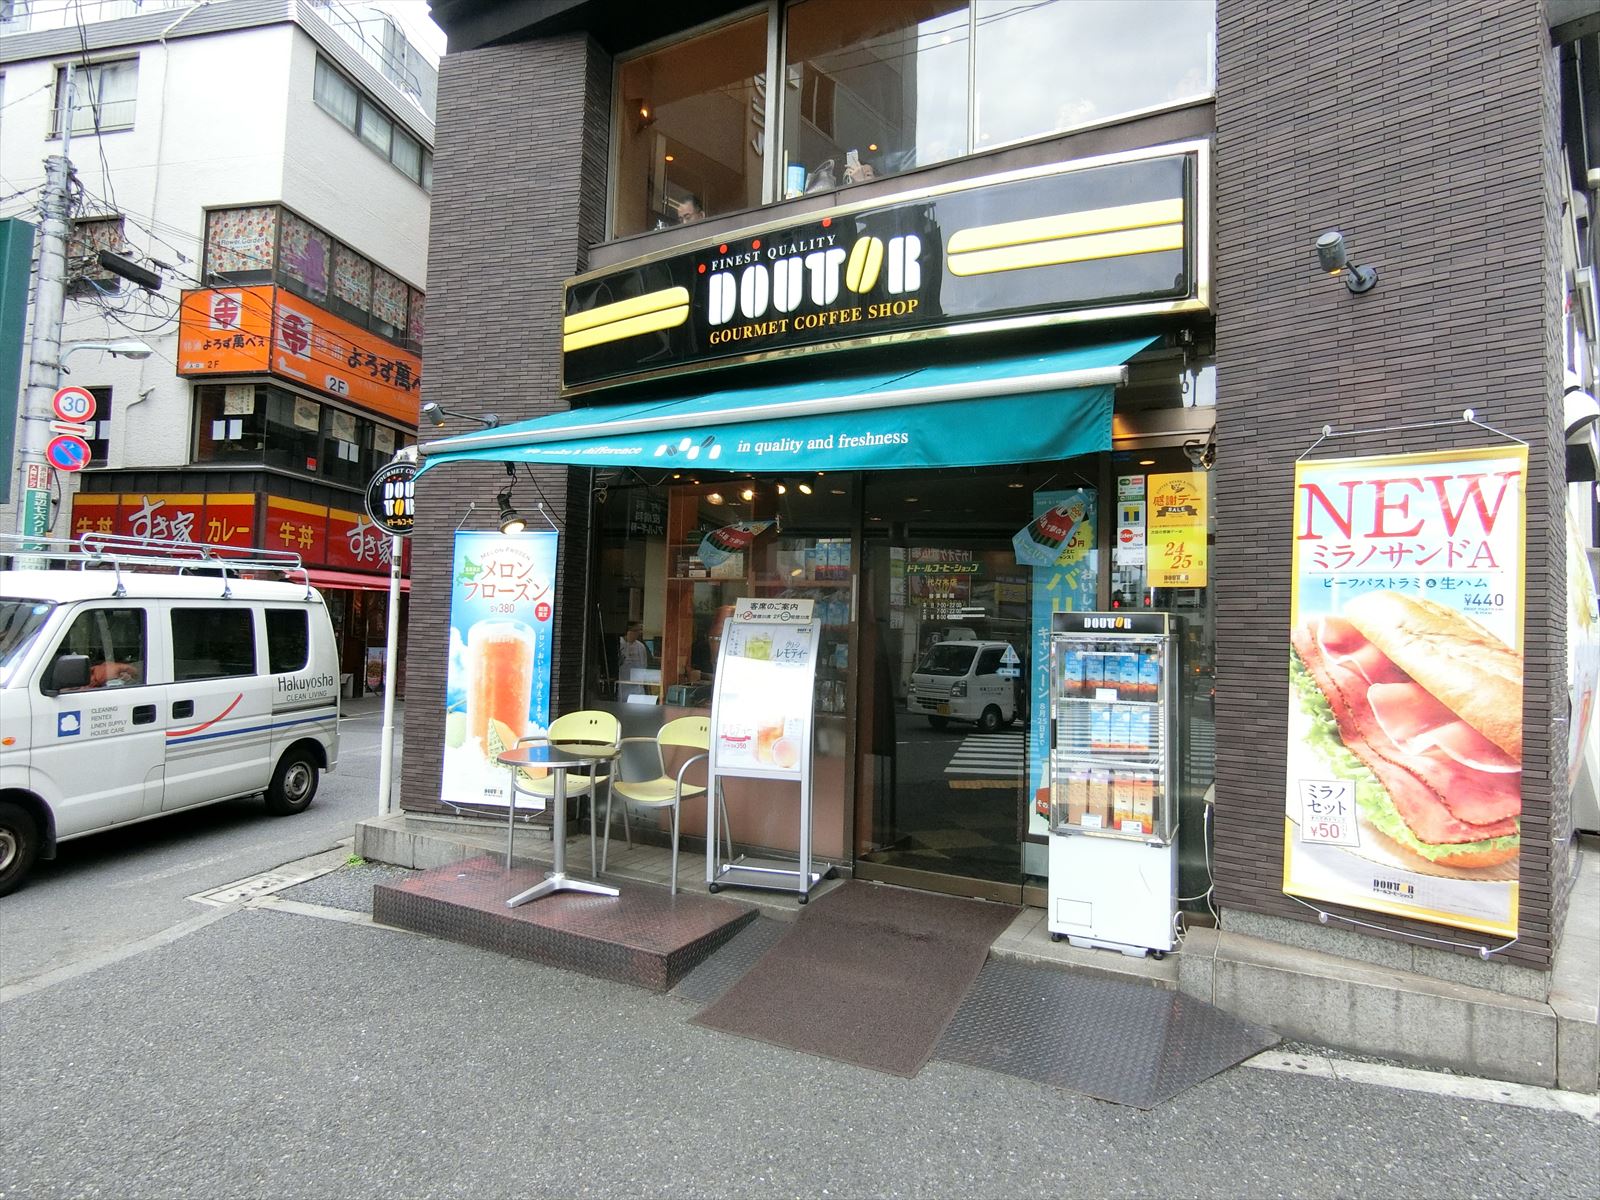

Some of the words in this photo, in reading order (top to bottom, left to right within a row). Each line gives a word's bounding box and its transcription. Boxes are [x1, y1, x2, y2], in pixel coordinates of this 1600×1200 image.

[711, 251, 760, 271] FINEST
[768, 234, 837, 260] QUALITY
[708, 235, 921, 326] DOUTOR
[709, 321, 789, 345] GOURMET
[794, 307, 862, 330] COFFEE
[868, 299, 919, 319] SHOP
[329, 377, 346, 393] 2F
[59, 394, 86, 414] 30
[583, 446, 642, 455] difference
[737, 440, 751, 453] in
[754, 436, 802, 455] quality
[807, 434, 834, 449] and
[838, 431, 908, 448] freshness
[376, 468, 404, 486] GOURMET
[1153, 494, 1200, 506] 感謝デー
[1297, 470, 1521, 540] NEW
[76, 517, 113, 534] 牛丼
[129, 495, 195, 549] すき家
[207, 521, 249, 543] カレー
[279, 522, 314, 549] 牛丼
[1165, 541, 1185, 556] 24
[1312, 539, 1500, 569] ミラノサンドA
[481, 560, 534, 580] メロン
[907, 563, 979, 573] ドトールコーヒーショップ
[1170, 555, 1192, 569] 25
[464, 578, 551, 602] フローズン
[1464, 593, 1504, 606] ¥440
[1084, 616, 1132, 629] DOUTOR
[776, 648, 808, 658] レモティー
[1038, 626, 1050, 699] キャンペーン
[278, 672, 334, 693] Hakuyosha
[286, 692, 307, 702] CLEAN
[308, 689, 328, 700] LIVING
[91, 706, 118, 714] CLEANING
[1308, 784, 1345, 799] ミラノ
[1307, 799, 1347, 816] セット
[1310, 823, 1339, 839] ¥50
